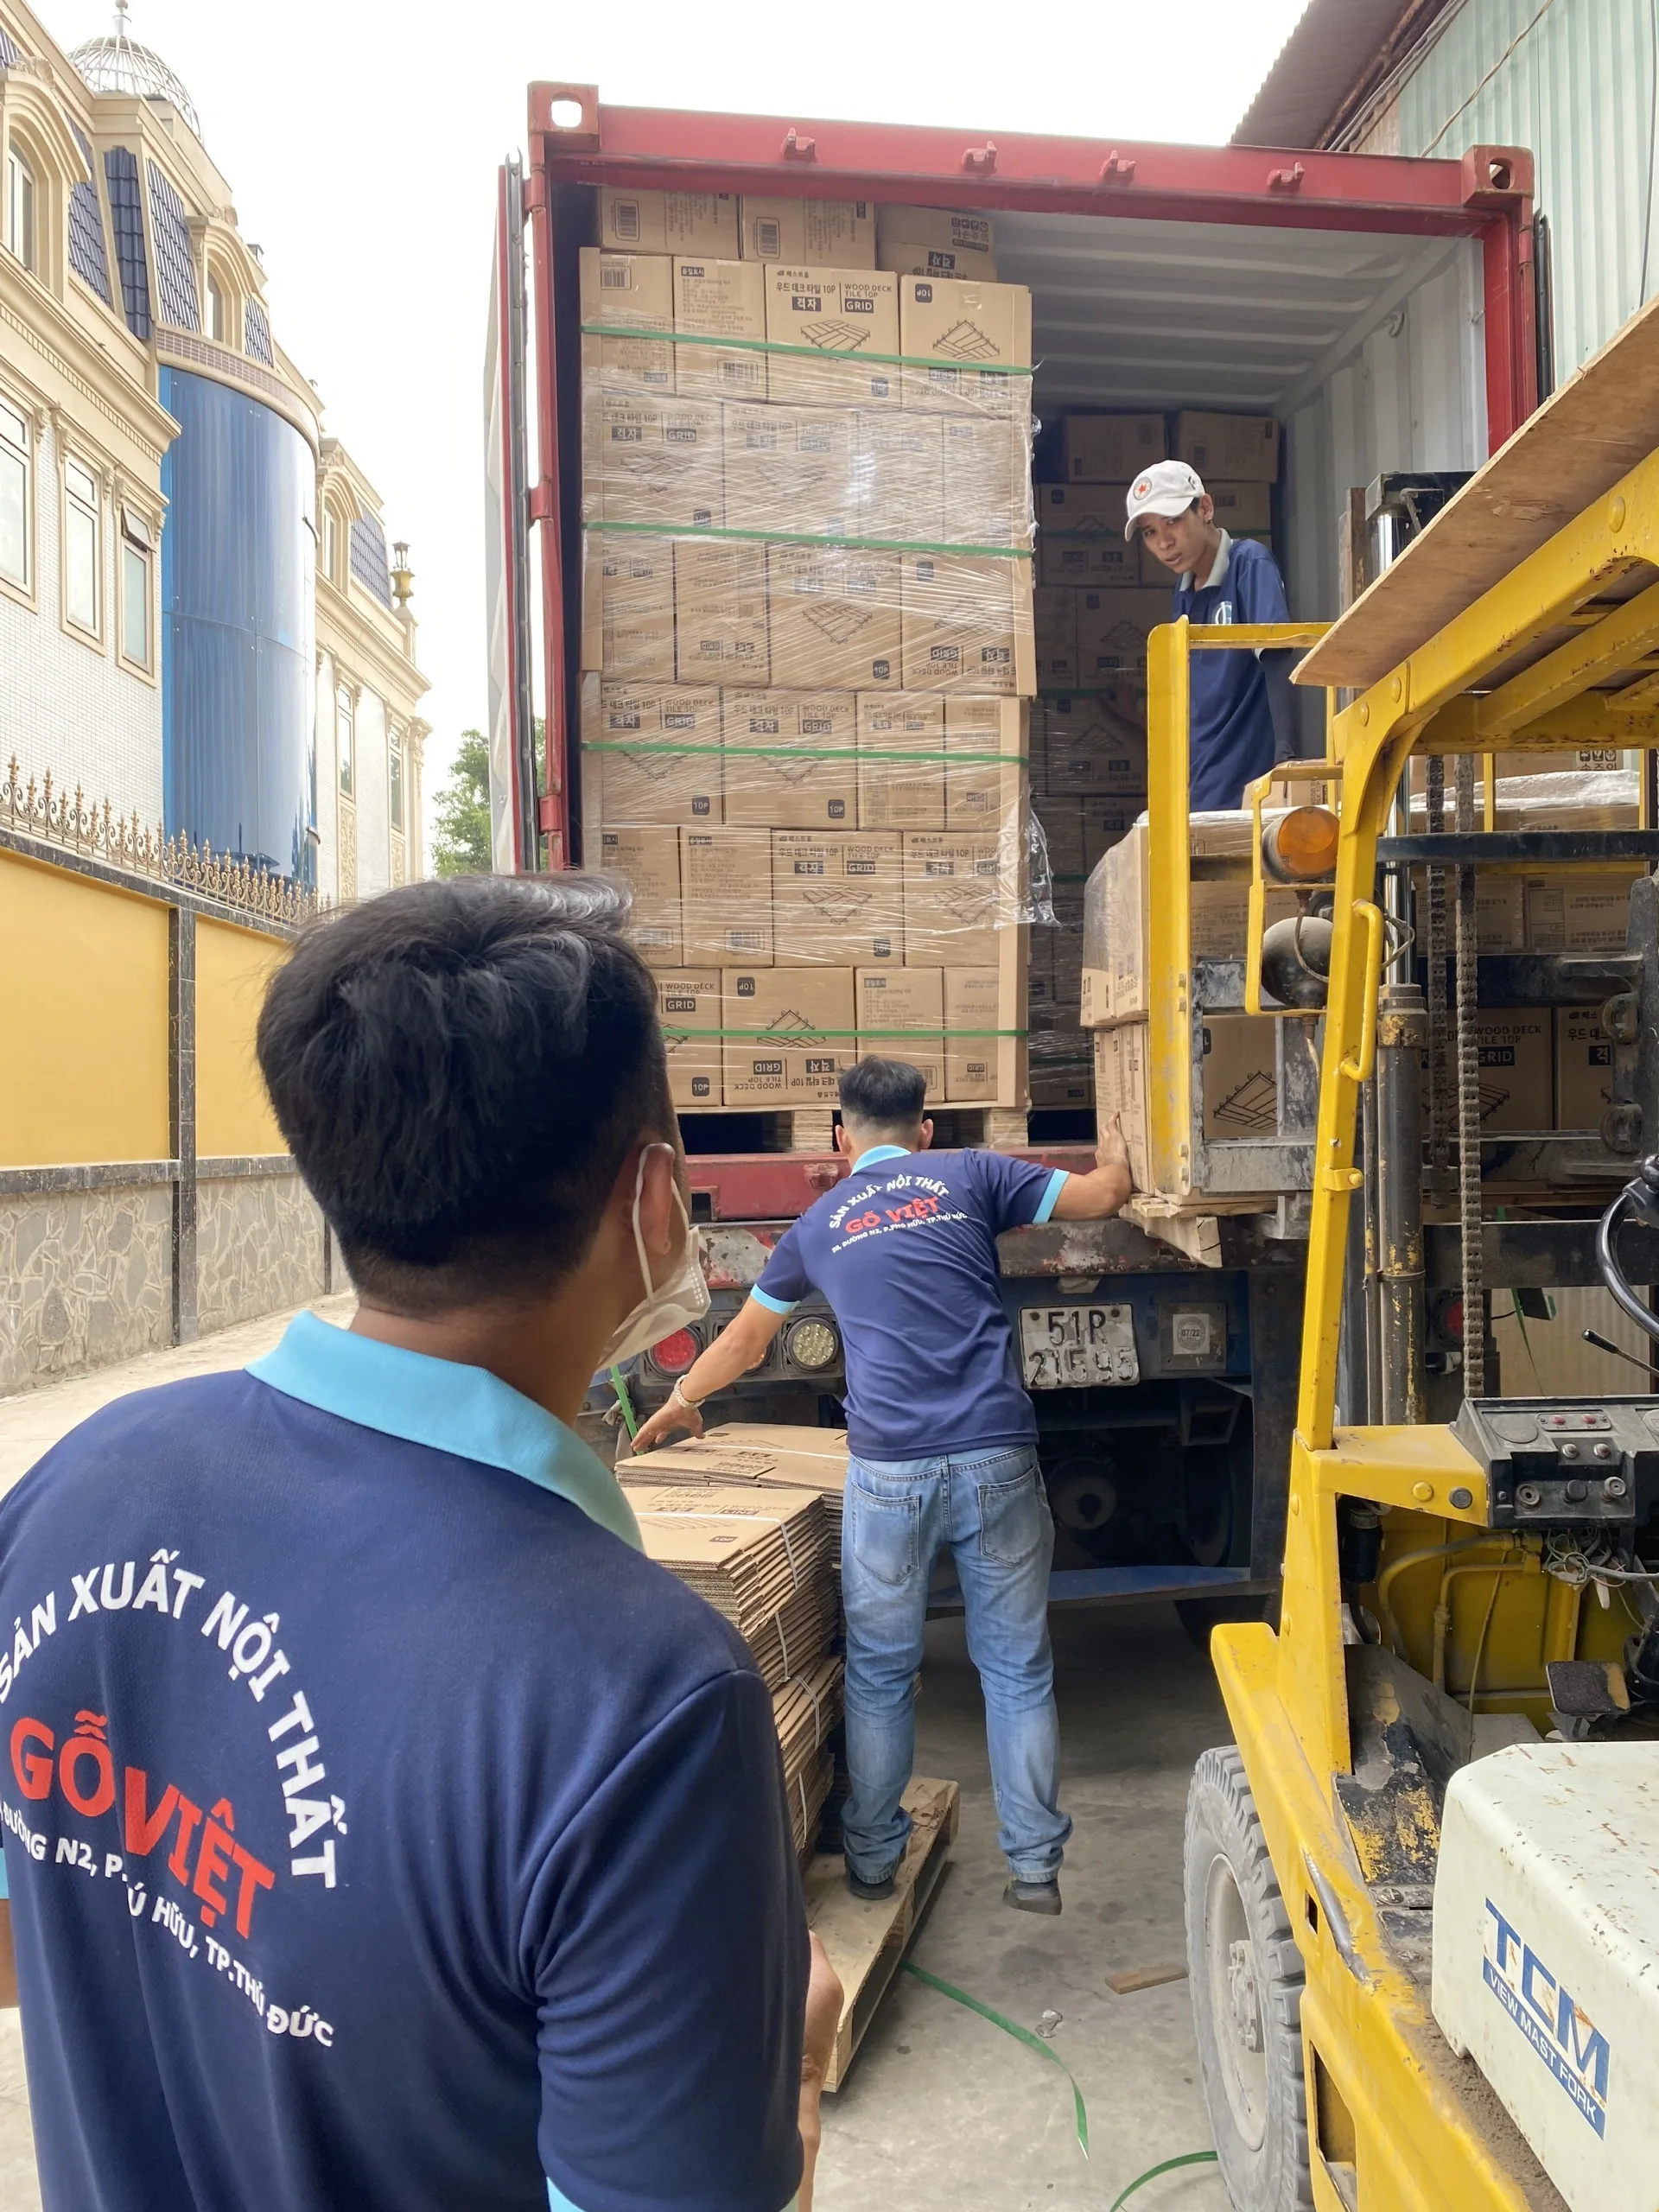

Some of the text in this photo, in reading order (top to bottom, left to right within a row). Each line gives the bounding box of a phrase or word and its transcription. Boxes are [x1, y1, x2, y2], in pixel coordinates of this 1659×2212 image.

[932, 252, 951, 268] 격자
[777, 283, 836, 295] 우드 데크 타일 10P
[917, 289, 931, 297] 10P
[797, 297, 817, 311] 격자
[846, 302, 873, 311] GRID
[668, 432, 696, 441] GRID
[932, 649, 957, 658] GRID
[641, 700, 656, 709] 10P
[667, 717, 694, 726] GRID
[804, 722, 831, 731] GRID
[693, 801, 709, 810] 10P
[829, 804, 843, 814] 10P
[849, 863, 874, 872] GRID
[668, 1001, 695, 1009] GRID
[1514, 1026, 1541, 1034] DECK
[1568, 1028, 1586, 1041] 우드
[1502, 1036, 1521, 1045] 10P
[1478, 1050, 1513, 1064] GRID
[755, 1063, 780, 1071] GRID
[810, 1060, 830, 1073] 격자
[791, 1077, 835, 1086] 데크 타일 10P
[847, 1183, 882, 1207] XUẤT
[887, 1174, 912, 1192] NỘI
[915, 1176, 949, 1197] THẤT
[845, 1195, 938, 1233] GỖ VIỆT
[1048, 1310, 1108, 1348] 51R
[1180, 1328, 1201, 1338] 07/22
[67, 1548, 206, 1621] XUẤT
[201, 1591, 291, 1703] NỘI
[267, 1691, 347, 1890] THẤT
[10, 1710, 276, 1940] GỖ VIỆT
[55, 1837, 97, 1878] N2,
[266, 2005, 334, 2048] ĐỨC
[1484, 1897, 1610, 2102] TCM
[1489, 1974, 1597, 2124] VIEW MAST FORK
